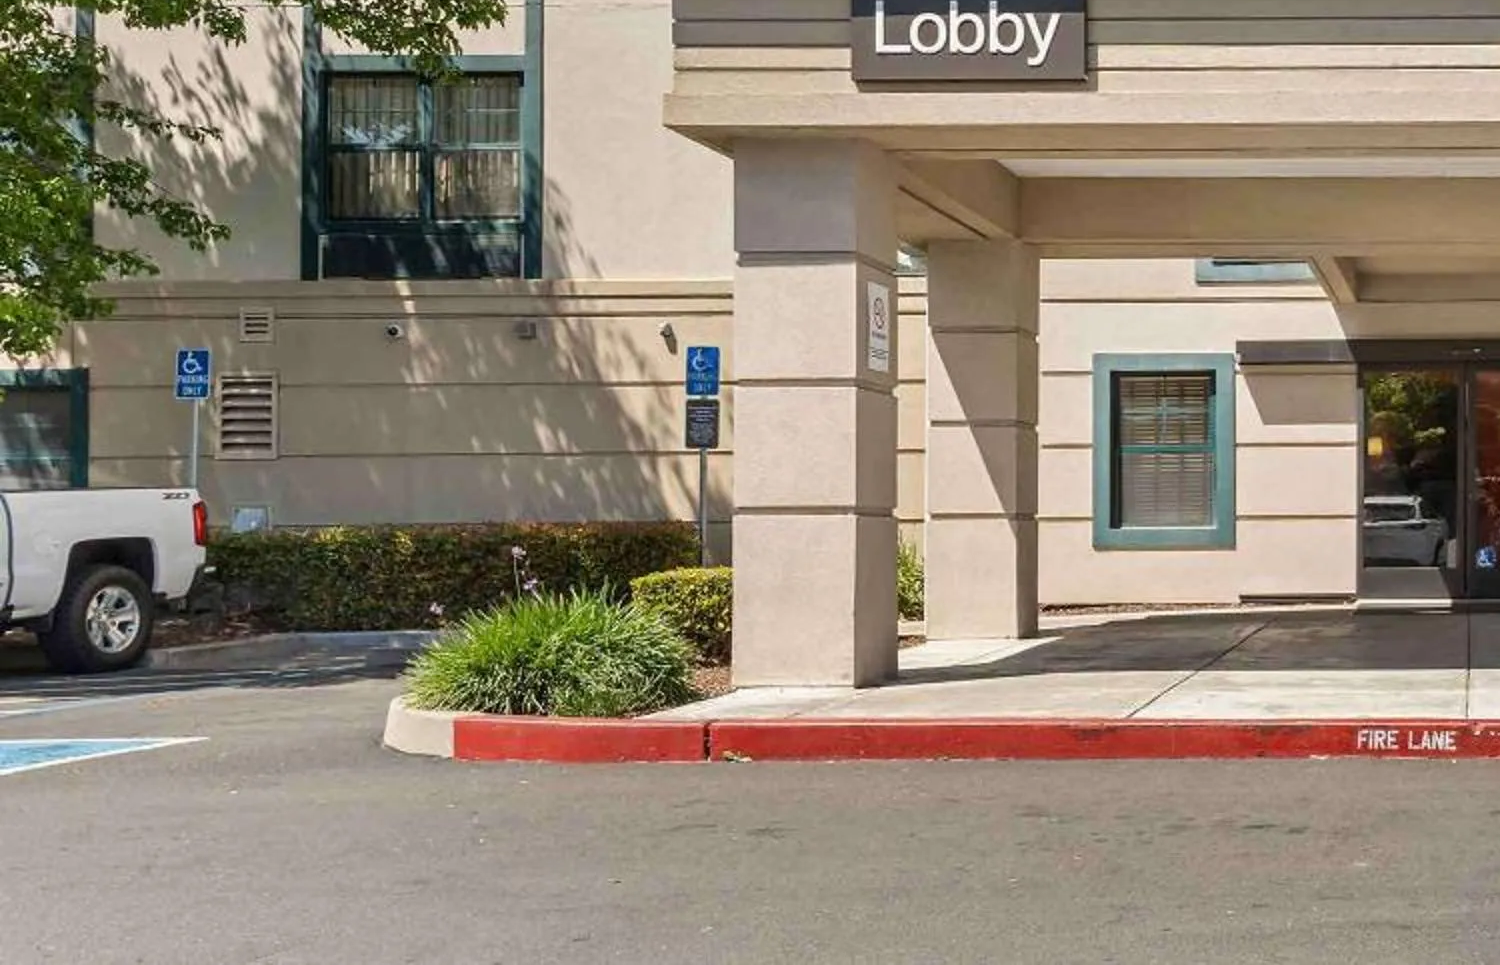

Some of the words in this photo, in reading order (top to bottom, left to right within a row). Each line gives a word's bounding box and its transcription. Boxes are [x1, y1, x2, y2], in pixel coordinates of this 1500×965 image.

[875, 0, 1061, 66] Lobby
[1356, 729, 1399, 750] FIRE
[1407, 730, 1457, 751] LANE
